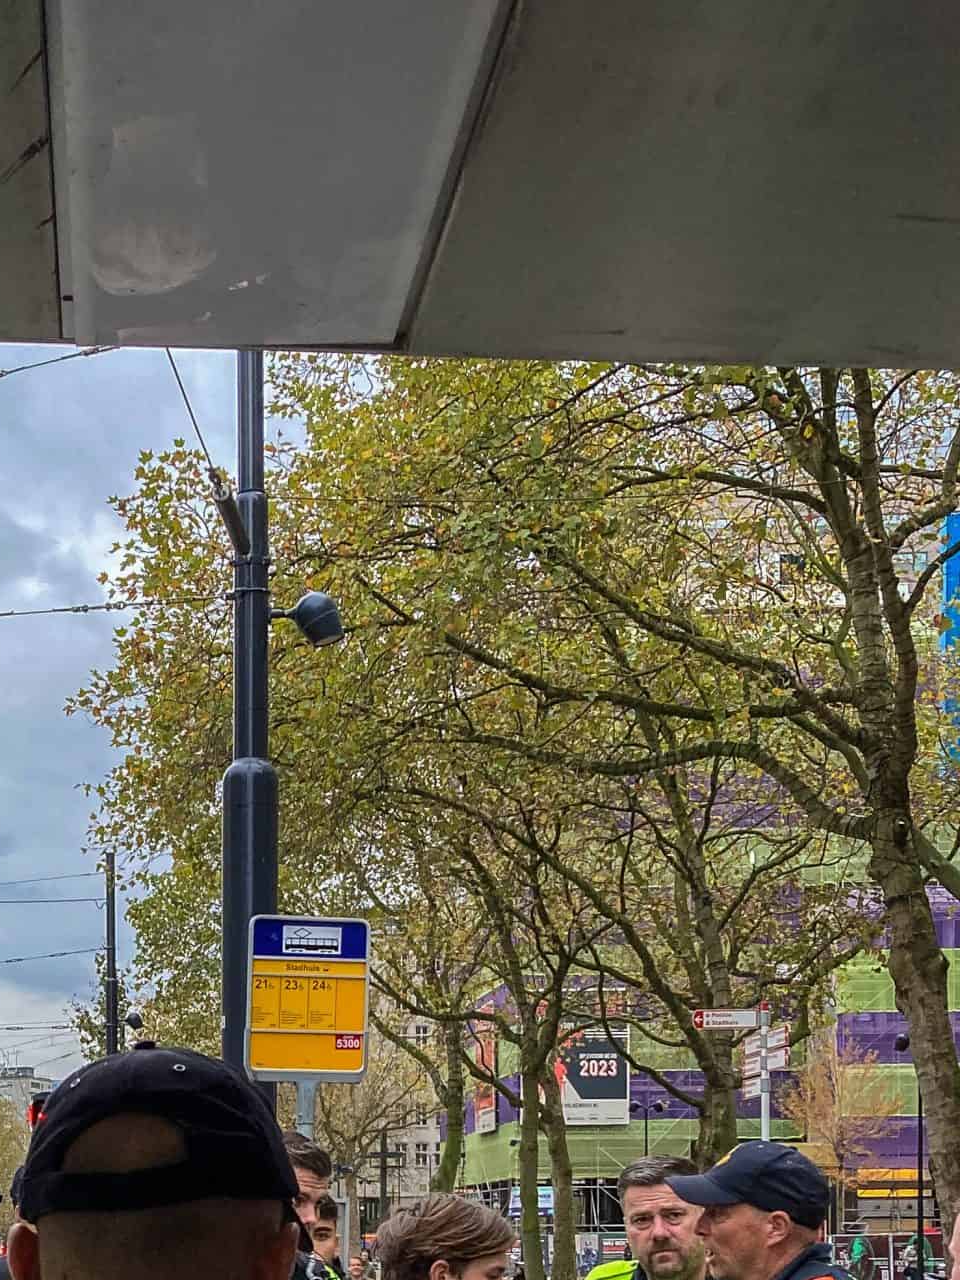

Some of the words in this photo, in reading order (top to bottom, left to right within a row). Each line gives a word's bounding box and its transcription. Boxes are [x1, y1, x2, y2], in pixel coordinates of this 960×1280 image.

[286, 963, 320, 972] Stadhuis
[255, 979, 268, 990] 21
[285, 980, 298, 990] 23
[312, 980, 326, 991] 24
[336, 1039, 360, 1049] 5300
[580, 1060, 617, 1076] 2023
